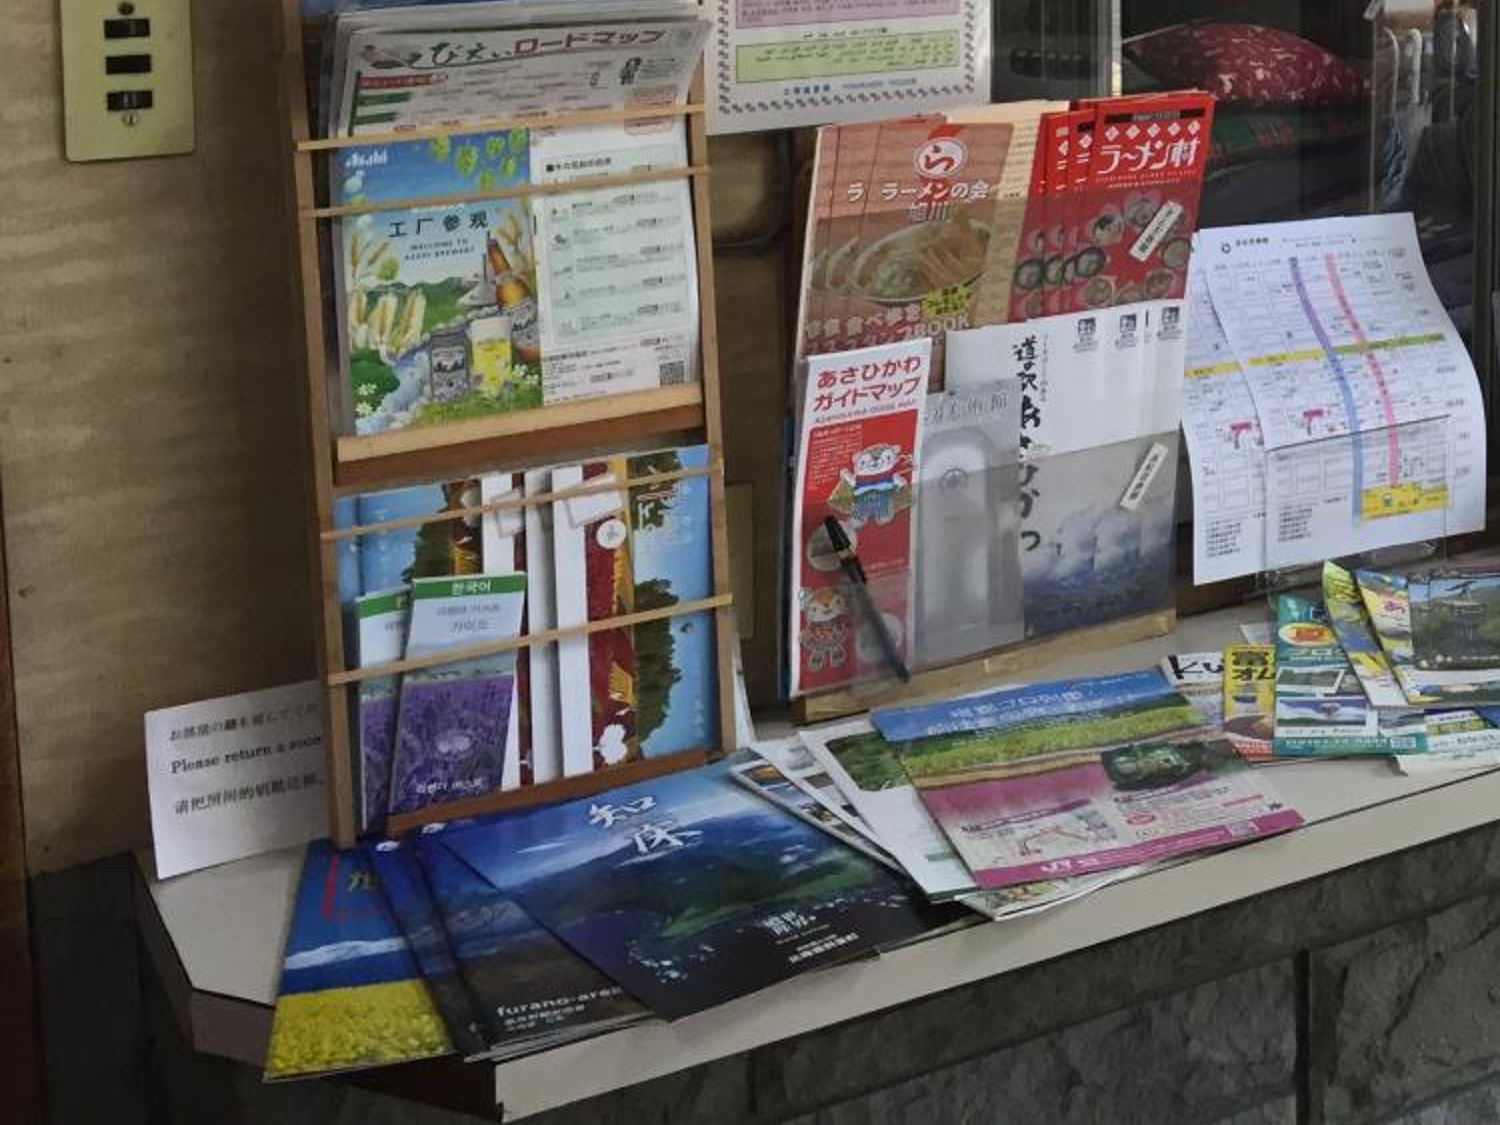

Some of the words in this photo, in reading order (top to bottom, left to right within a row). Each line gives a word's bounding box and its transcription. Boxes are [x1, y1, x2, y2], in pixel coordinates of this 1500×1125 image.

[880, 179, 991, 202] ラーメンの会
[388, 209, 490, 239] 工厂参观
[816, 355, 922, 389] あさひかわ
[813, 376, 921, 412] ガイドマップ
[451, 580, 492, 596] 한국어
[170, 757, 221, 775] Please
[224, 745, 272, 764] return
[588, 794, 704, 855] 知床
